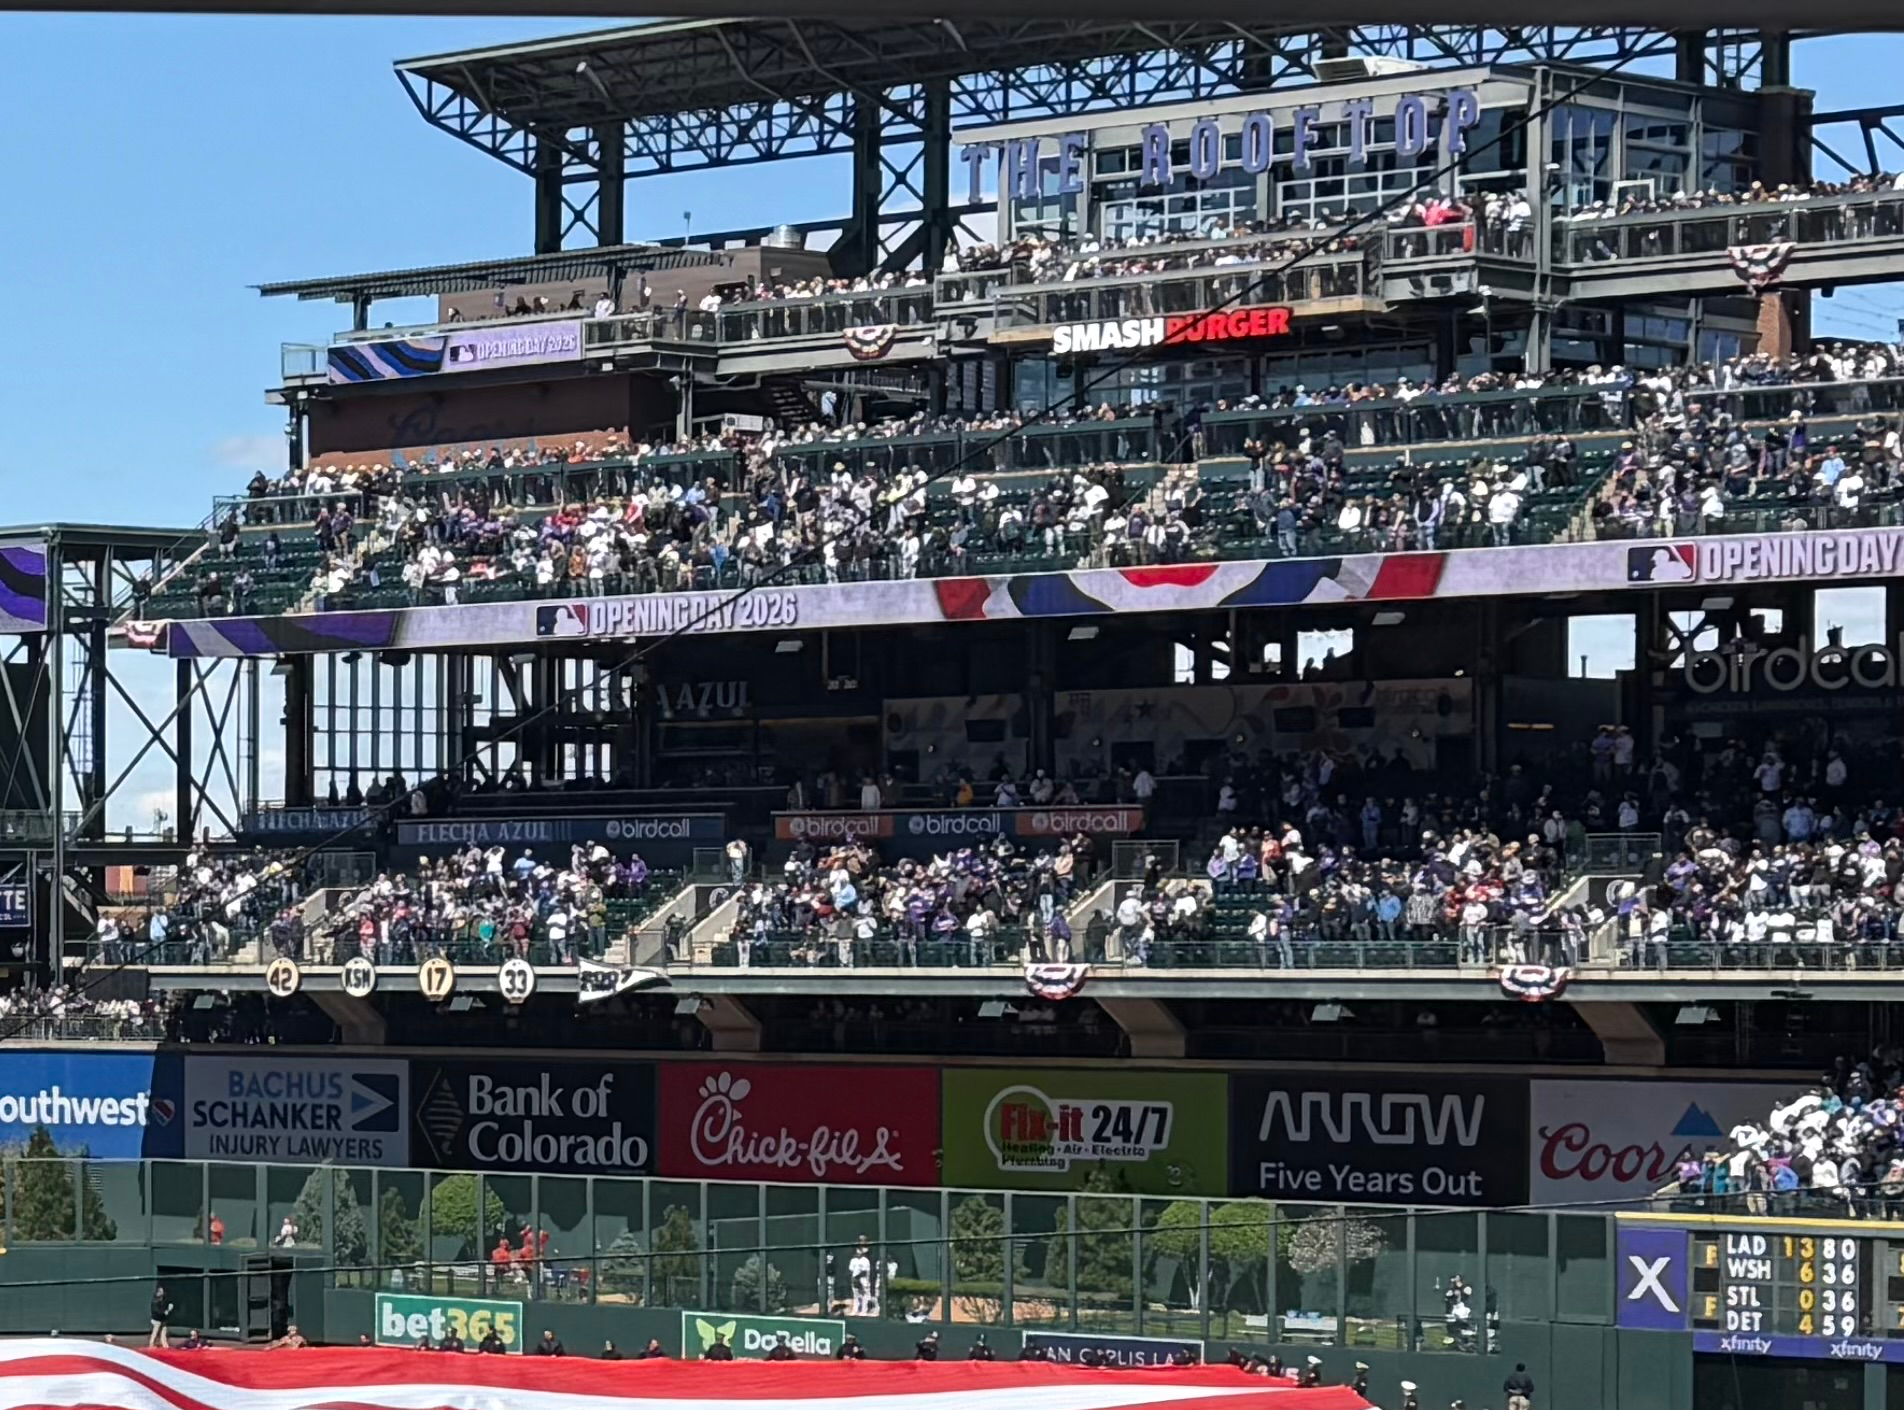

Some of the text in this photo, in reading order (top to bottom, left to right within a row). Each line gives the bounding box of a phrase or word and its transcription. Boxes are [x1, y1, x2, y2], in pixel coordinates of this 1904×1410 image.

[961, 88, 1480, 204] THE ROOFTOP
[1052, 307, 1292, 354] SMASHBURGER
[1700, 533, 1899, 580] OPENING DAY
[592, 592, 798, 638] OPENING DAY 2026
[417, 821, 549, 843] FLECHA AZUL
[621, 818, 690, 839] birdcall
[804, 815, 879, 836] birdcall
[923, 813, 1001, 836] birdcall
[1046, 811, 1129, 834] birdcall
[269, 967, 292, 988] 42
[345, 967, 371, 988] KSM
[427, 967, 447, 989] 17
[504, 969, 529, 994] 33
[228, 1070, 343, 1100] BACHUS
[468, 1072, 614, 1117] Bank of
[193, 1101, 342, 1132] SCHANKER
[1000, 1103, 1169, 1145] Fix-it 24/7
[1259, 1090, 1485, 1147] ARROW
[209, 1133, 383, 1160] INJURY LAWYERS
[467, 1120, 648, 1168] Colorado
[1092, 1145, 1145, 1157] Electric
[1259, 1162, 1483, 1197] Five Years Out
[1727, 1233, 1767, 1257] LAD
[1822, 1238, 1856, 1261] 80
[1628, 1254, 1680, 1312] X
[1727, 1257, 1856, 1285] WSH 6 36
[1726, 1285, 1856, 1312] STL 0 36
[381, 1301, 515, 1345] bet365
[1726, 1311, 1763, 1332] DET
[1798, 1315, 1815, 1335] 4
[1822, 1314, 1856, 1338] 59
[743, 1326, 832, 1355] DaBella
[1720, 1334, 1773, 1354] xfinity
[1830, 1339, 1884, 1361] xfinity
[1079, 1348, 1146, 1367] CPLIS
